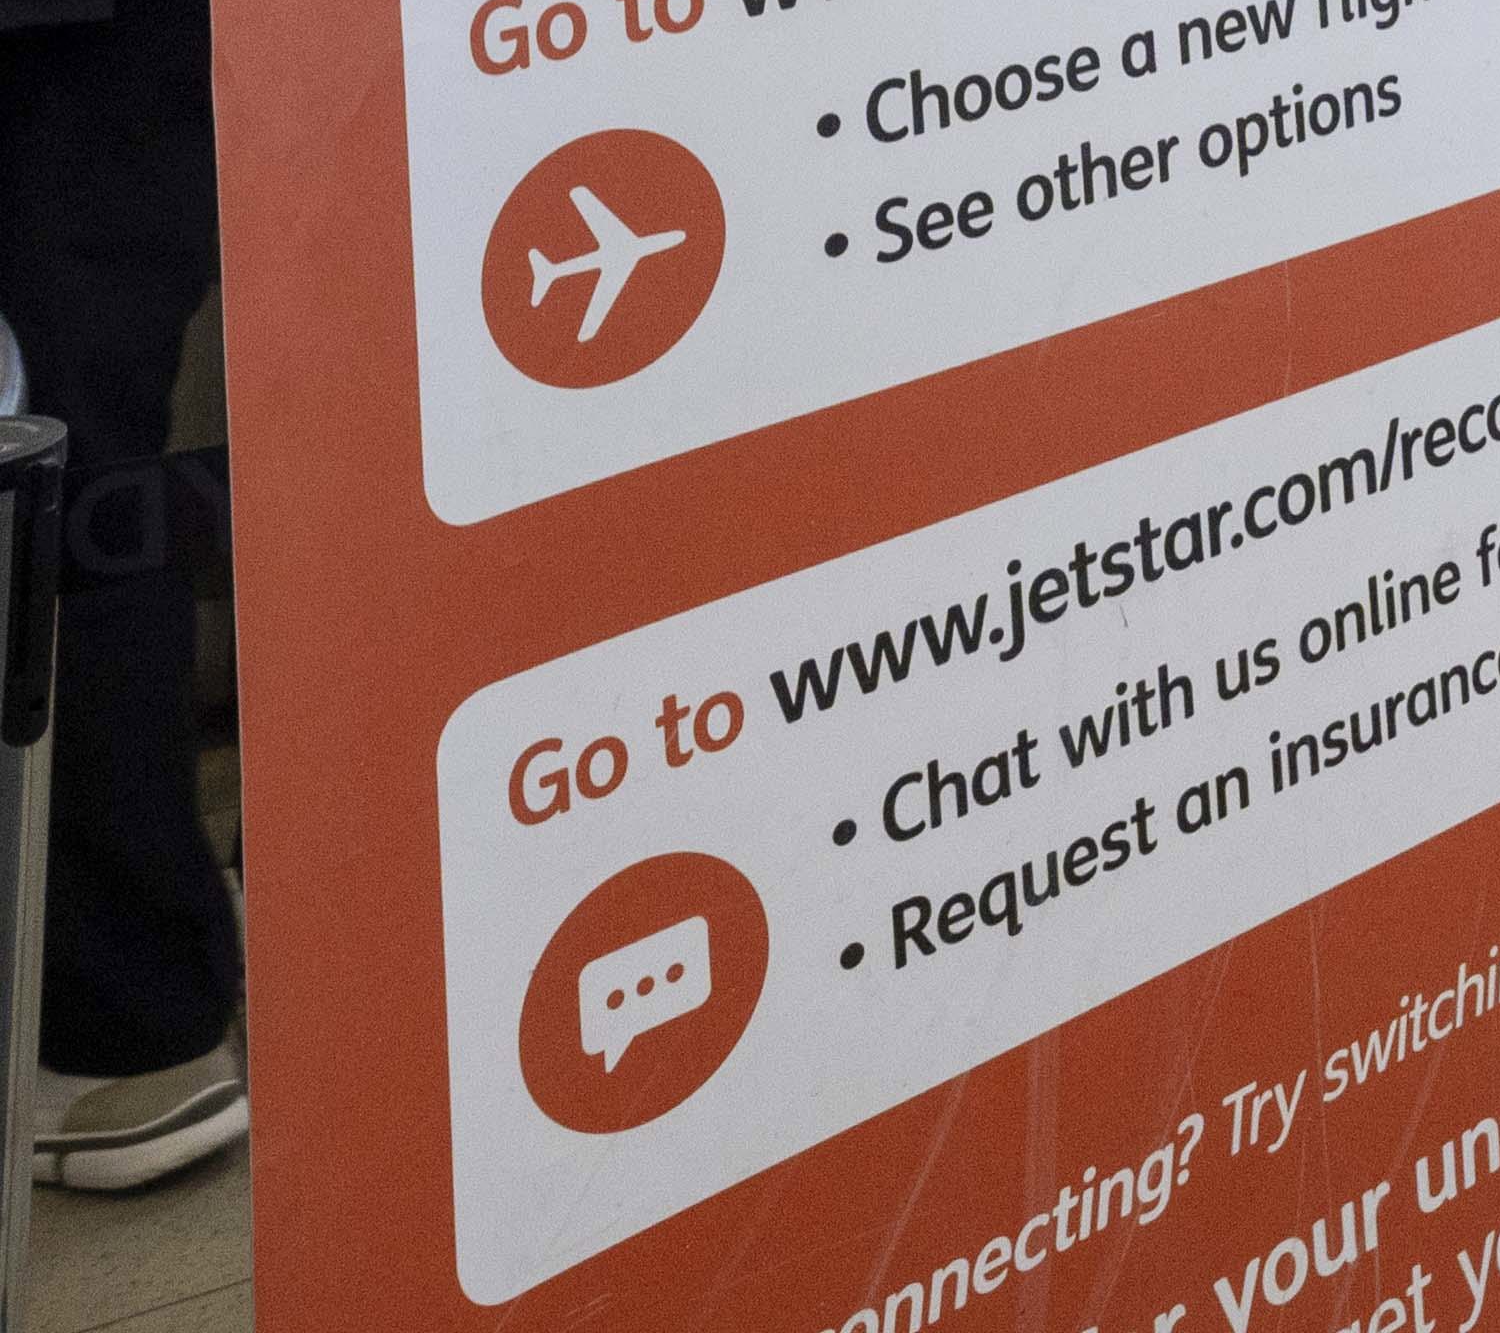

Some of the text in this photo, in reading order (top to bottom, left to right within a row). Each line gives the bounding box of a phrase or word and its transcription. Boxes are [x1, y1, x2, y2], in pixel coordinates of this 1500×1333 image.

[866, 45, 1101, 143] Choose
[1121, 33, 1157, 77] a
[874, 73, 1402, 265] See other options
[507, 735, 628, 825] Go
[655, 690, 745, 768] to
[881, 730, 1040, 846] Chat
[1059, 666, 1195, 770] with
[1216, 640, 1281, 701] us
[1300, 561, 1462, 665] online
[890, 798, 1158, 973] Request
[1175, 768, 1252, 837] an
[818, 1114, 1206, 1333] onnecting?
[1223, 1078, 1308, 1157] Try
[1213, 1181, 1391, 1333] your
[1335, 1264, 1436, 1333] et
